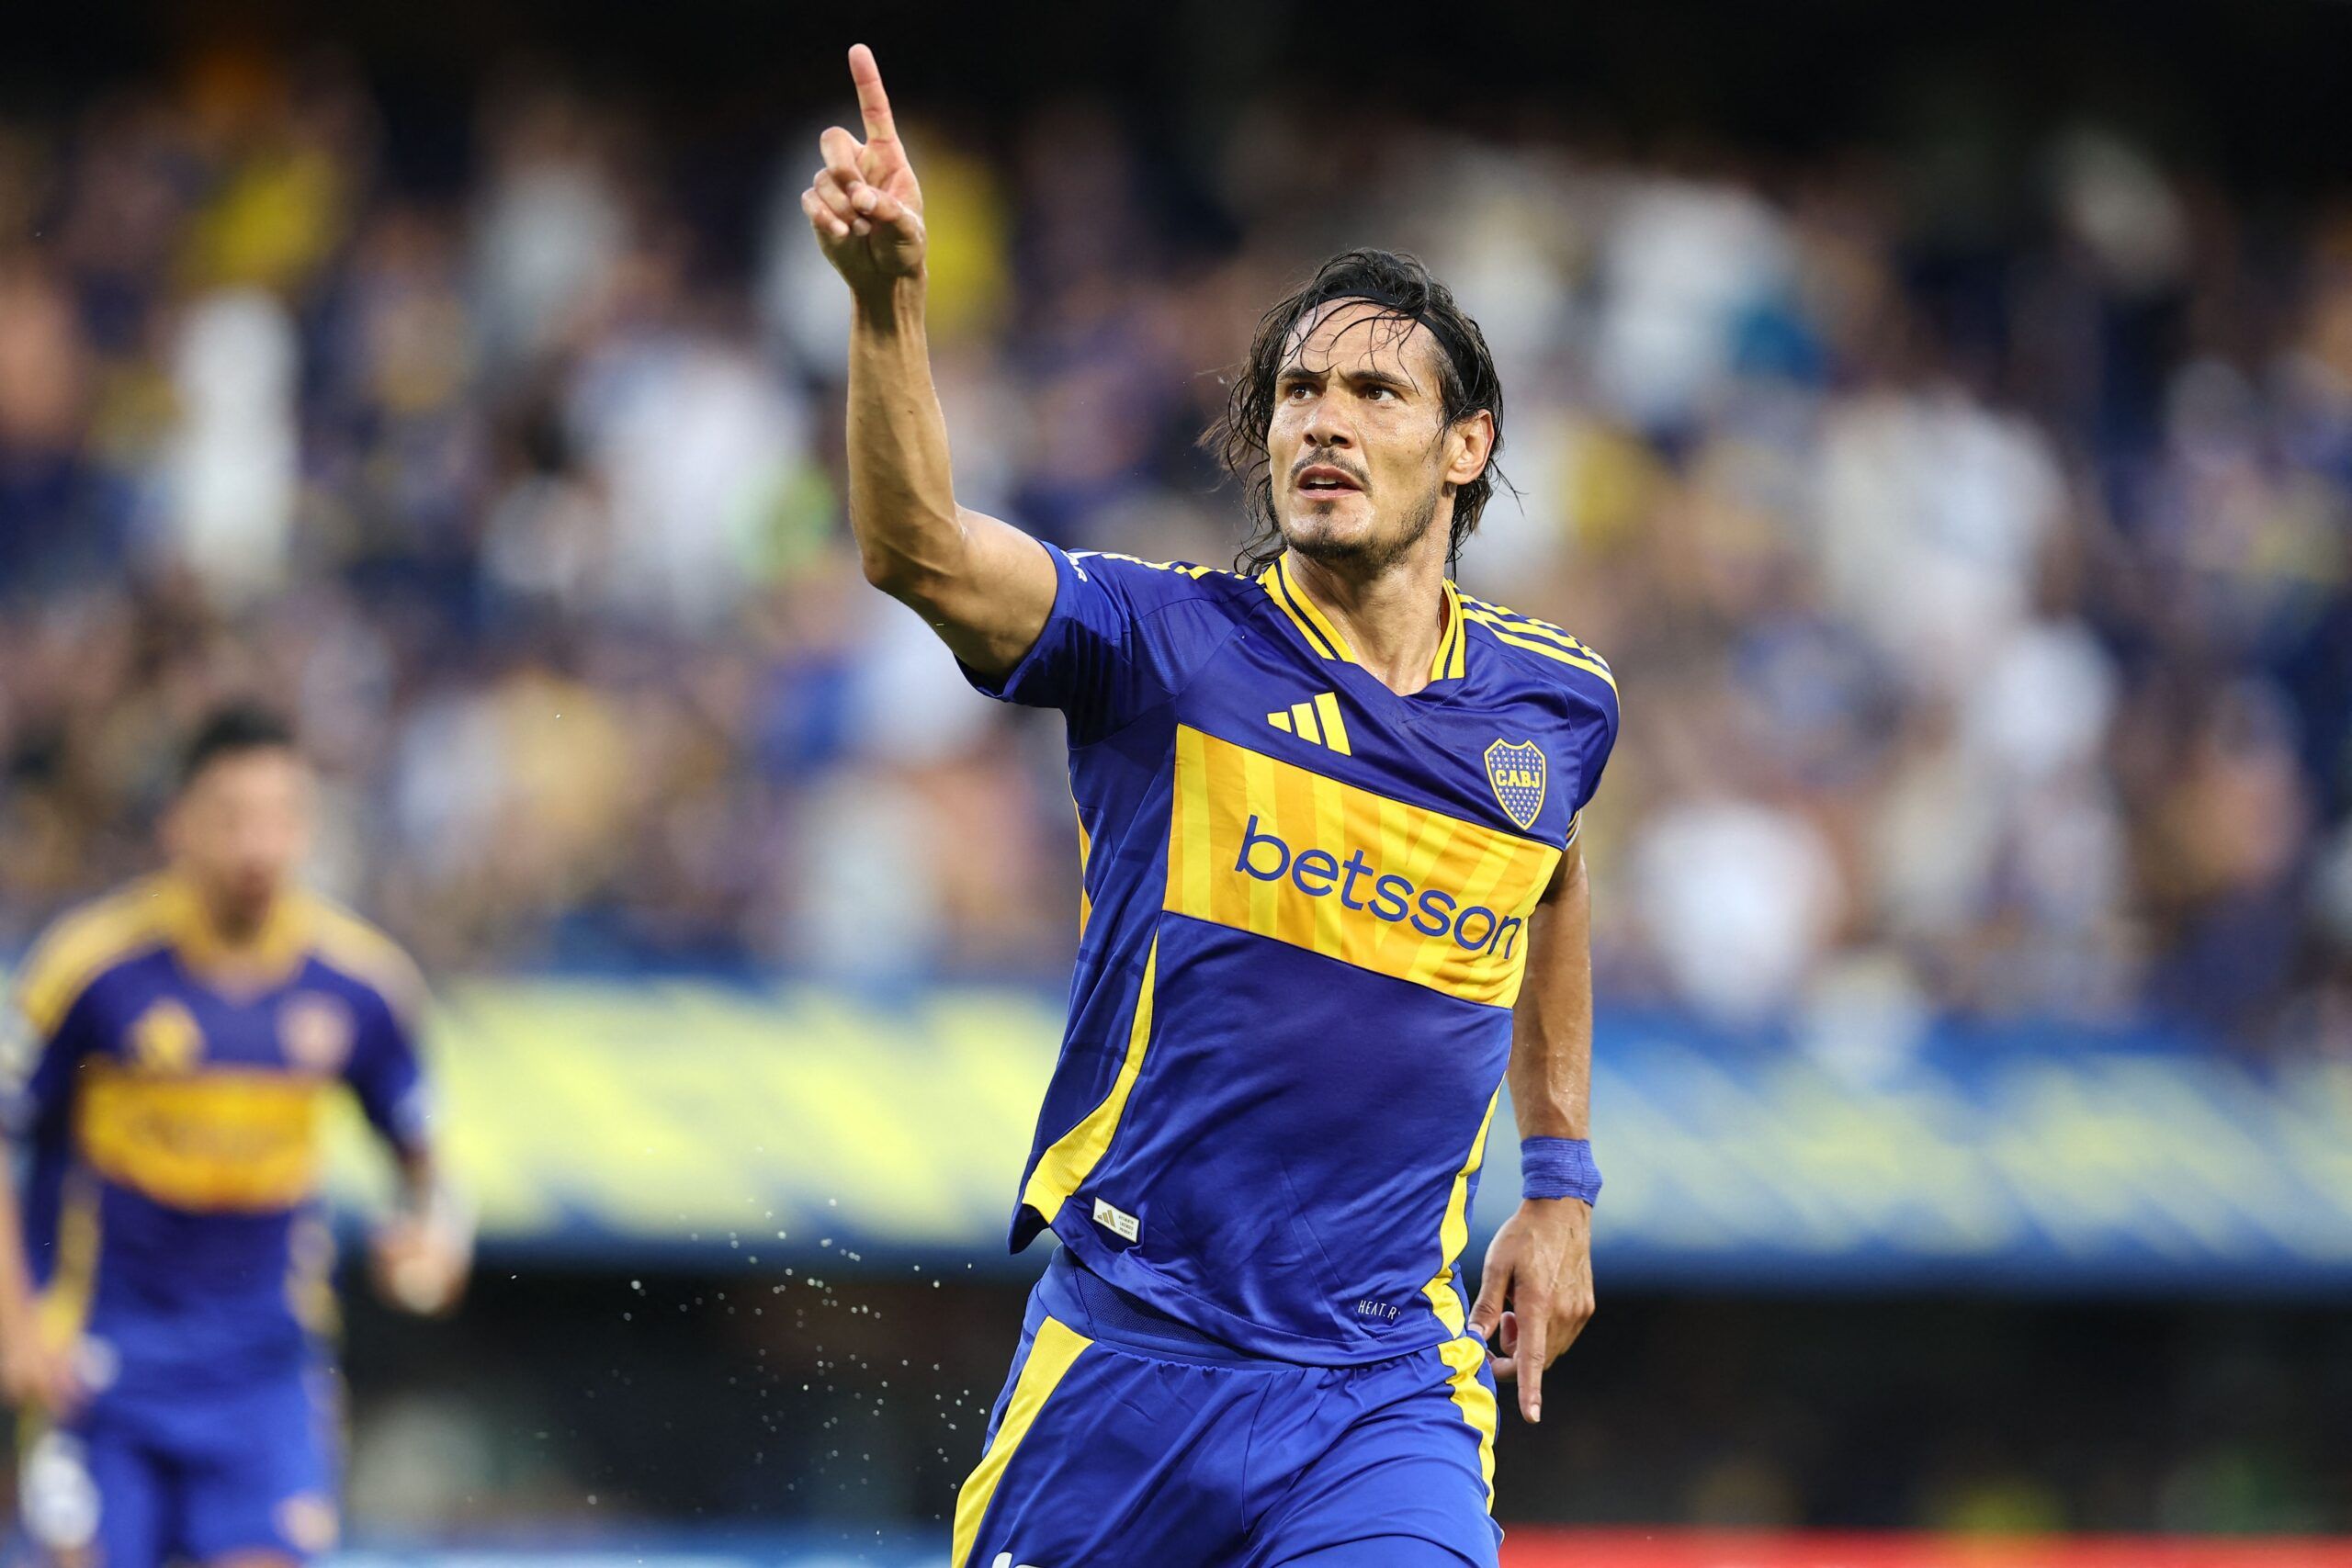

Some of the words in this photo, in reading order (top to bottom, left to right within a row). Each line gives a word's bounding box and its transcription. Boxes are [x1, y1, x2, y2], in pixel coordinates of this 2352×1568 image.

[1495, 769, 1540, 788] CABJ
[1235, 814, 1521, 959] betsson
[1357, 1299, 1401, 1320] HEAT.R
